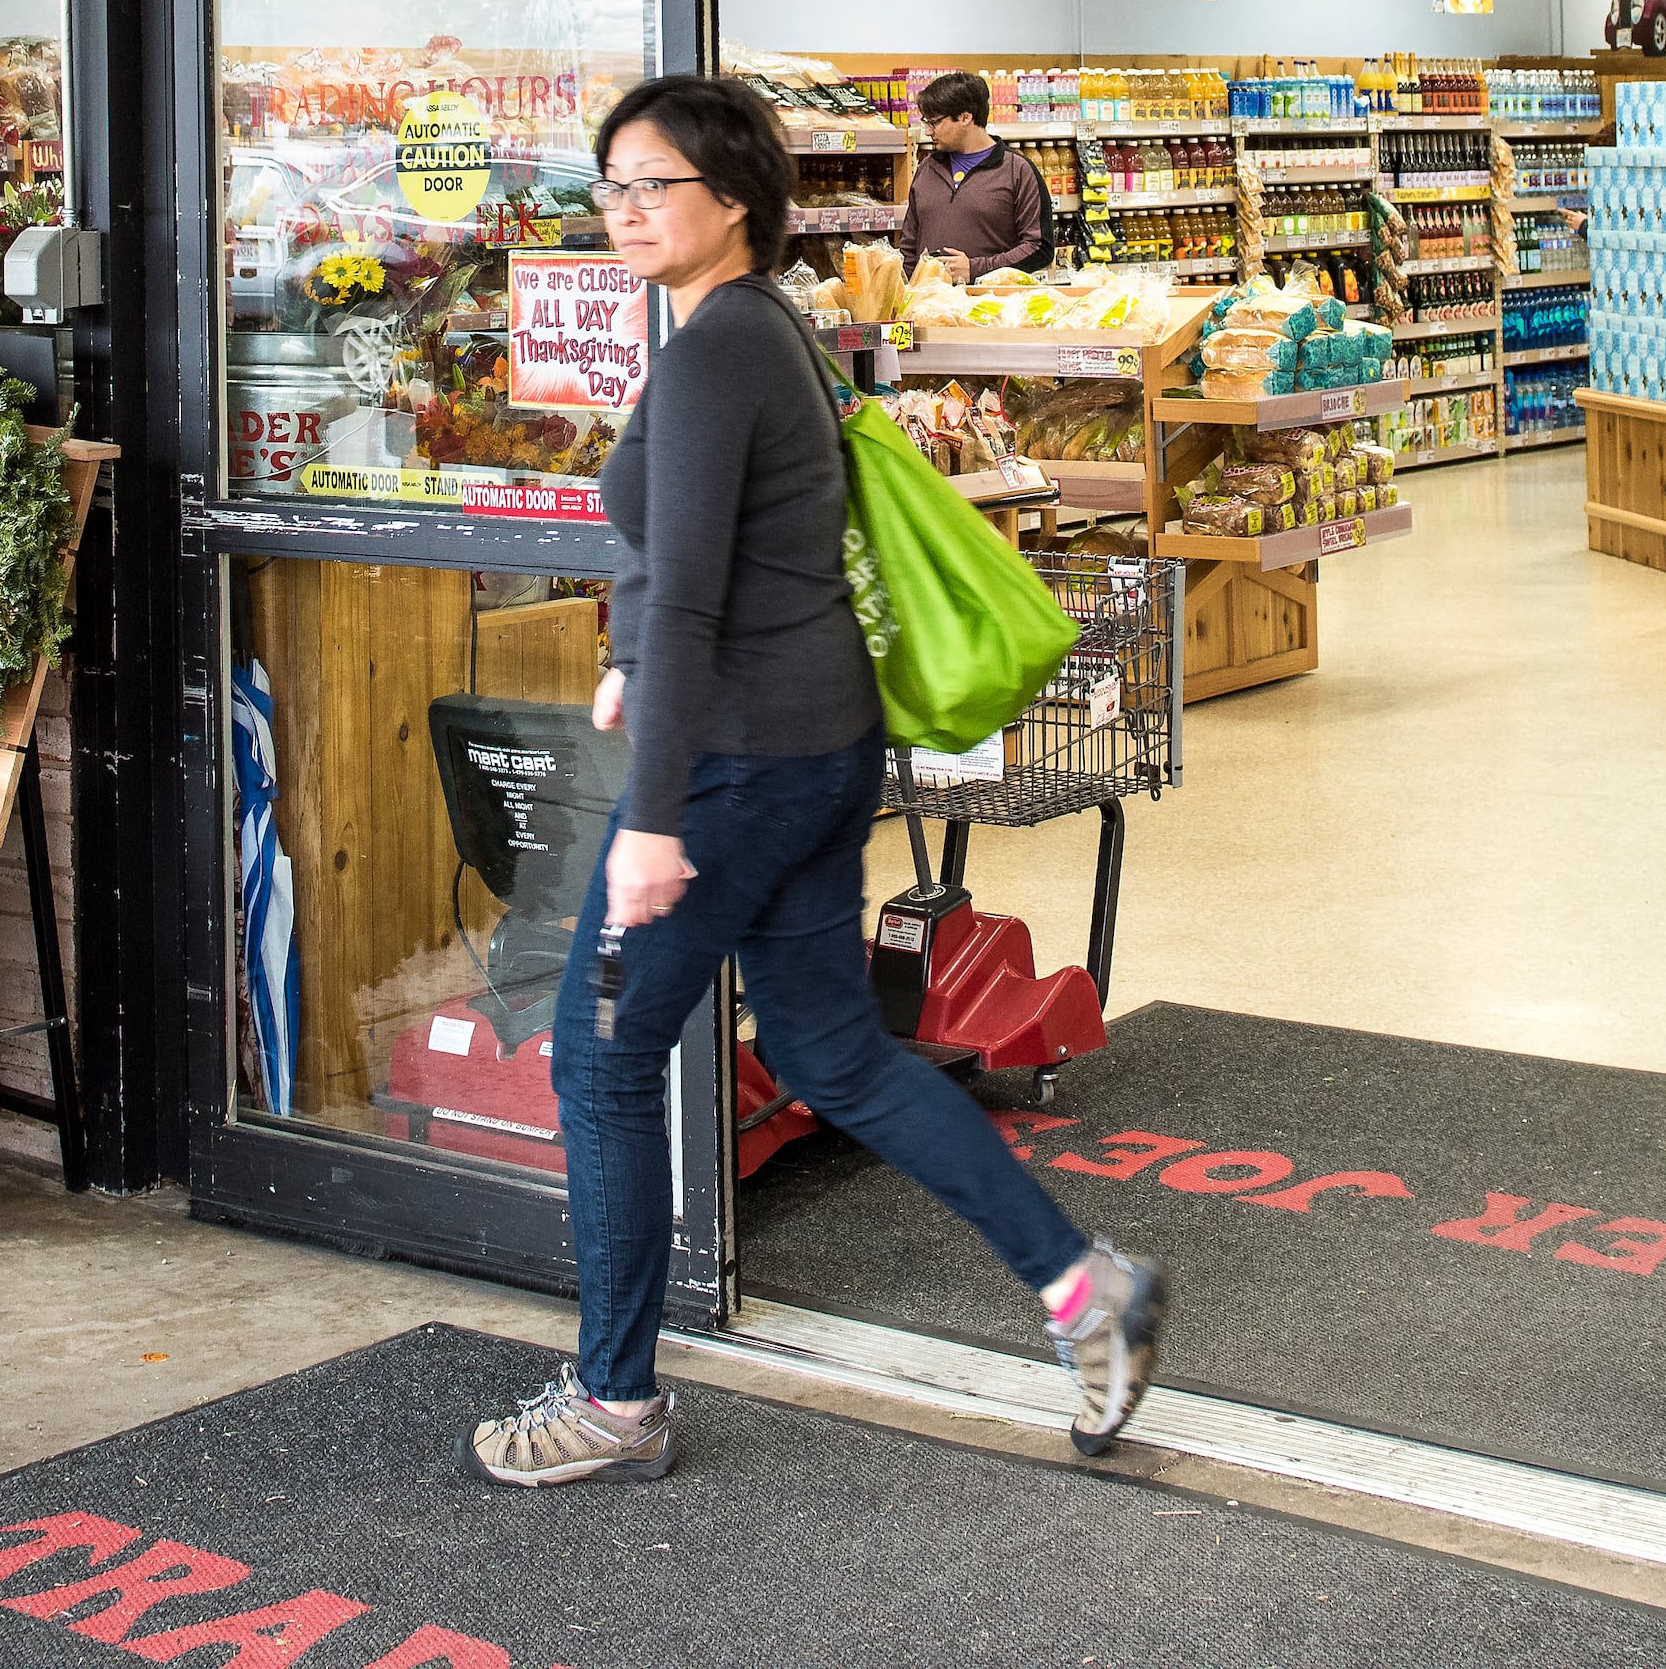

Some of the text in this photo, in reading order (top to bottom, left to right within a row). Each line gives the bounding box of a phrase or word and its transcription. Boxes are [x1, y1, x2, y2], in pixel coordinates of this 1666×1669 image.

[404, 122, 481, 139] AUTOMATIC
[400, 144, 485, 170] CAUTION
[424, 176, 464, 192] DOOR
[547, 270, 574, 292] are
[578, 267, 642, 294] CLOSED
[531, 298, 619, 333] ALL DAY
[513, 329, 642, 378] Thanksgiving
[588, 371, 628, 409] Day
[231, 449, 294, 483] E'S
[311, 471, 369, 492] AUTOMATIC
[370, 474, 400, 493] DOOR
[424, 475, 458, 497] STAND
[462, 486, 523, 510] AUTOMATIC
[526, 489, 557, 511] DOOR
[491, 779, 537, 792] CHARGE EVERY
[506, 791, 524, 800] NIGHT
[503, 800, 534, 811] ALL NIGHT
[514, 812, 528, 820] AND
[515, 830, 535, 840] EVERY
[519, 822, 527, 830] AT
[508, 838, 549, 852] OPPORTUNITY
[436, 1107, 552, 1137] DO NOT STAND ON BUMPER
